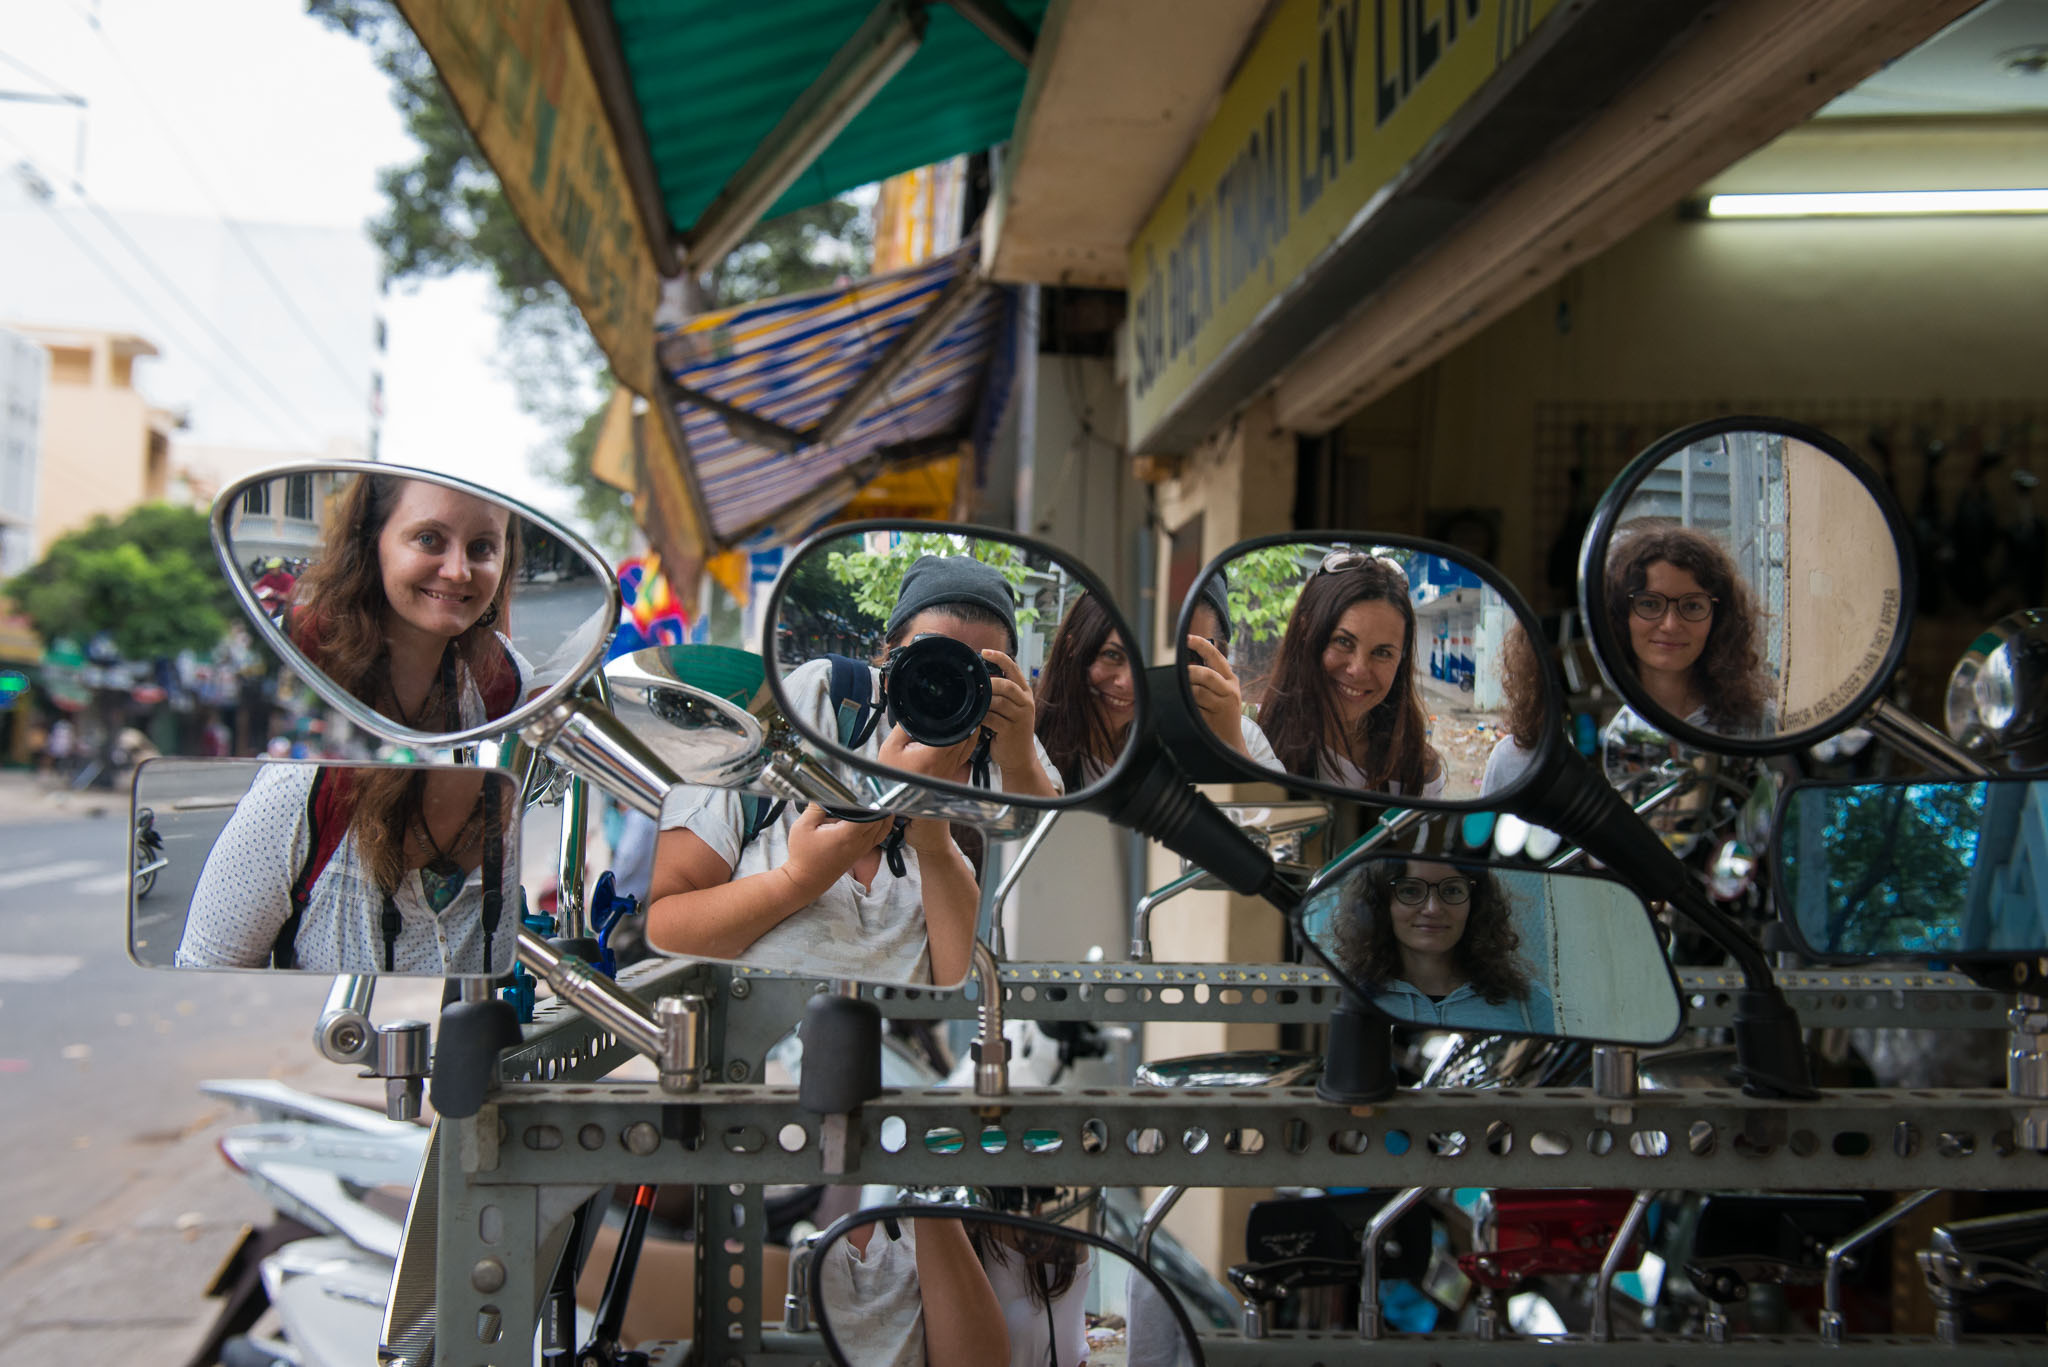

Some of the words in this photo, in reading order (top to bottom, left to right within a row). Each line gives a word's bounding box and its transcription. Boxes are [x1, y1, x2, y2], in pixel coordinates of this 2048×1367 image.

[1814, 700, 1833, 717] ARE
[1857, 650, 1880, 676] THAN
[1870, 628, 1890, 652] THEY
[1880, 588, 1899, 625] APPEAR
